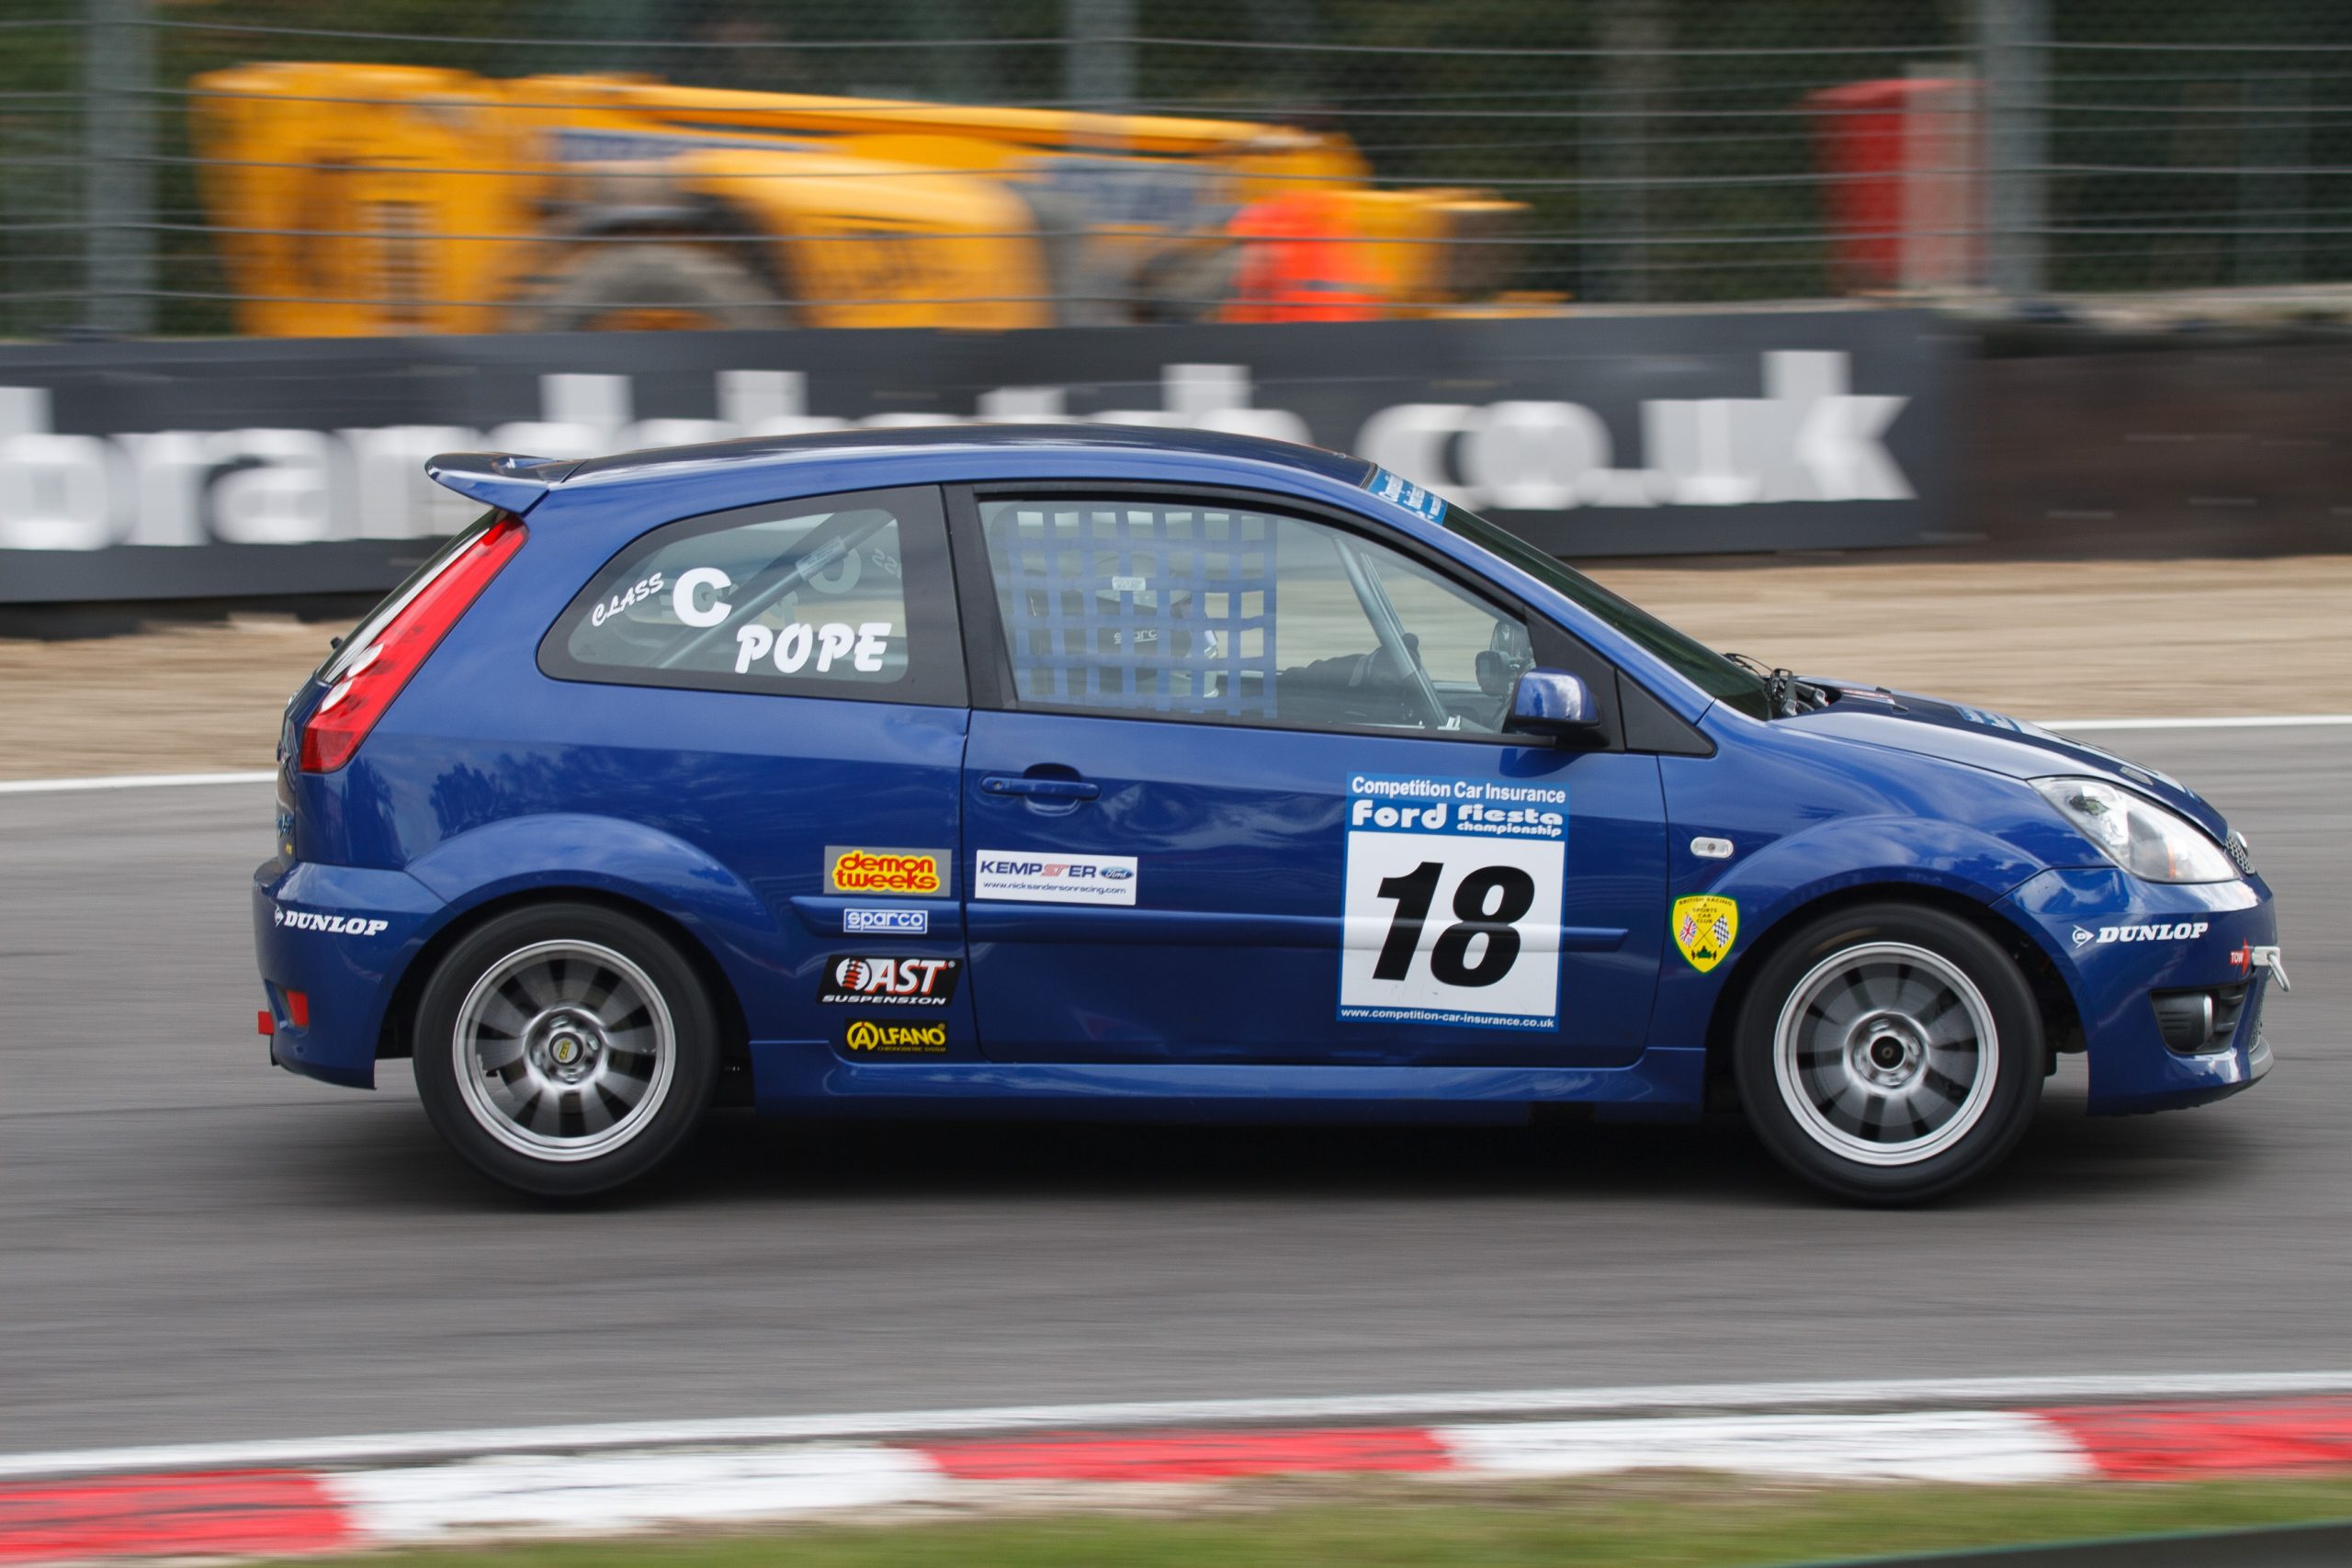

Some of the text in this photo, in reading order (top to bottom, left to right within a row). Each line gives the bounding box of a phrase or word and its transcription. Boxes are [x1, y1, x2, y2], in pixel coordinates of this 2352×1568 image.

[592, 572, 664, 626] CLASS
[673, 567, 732, 627] C
[735, 622, 892, 673] POPE
[1352, 776, 1566, 804] Competition Car Insurance
[1456, 822, 1562, 837] championship
[840, 853, 933, 874] demon
[980, 861, 1097, 878] KEMPSTER
[835, 869, 937, 889] tweeks
[983, 882, 1126, 895] www.nicksandersonracing.com
[285, 910, 389, 936] DUNLOP
[847, 912, 923, 931] sparco
[1373, 862, 1535, 987] 18
[2096, 922, 2209, 943] DUNLOP
[822, 995, 946, 1005] SUSPENSION
[1340, 1008, 1555, 1028] www.competition-car-insurance.co.uk
[846, 1021, 945, 1051] ALFANO
